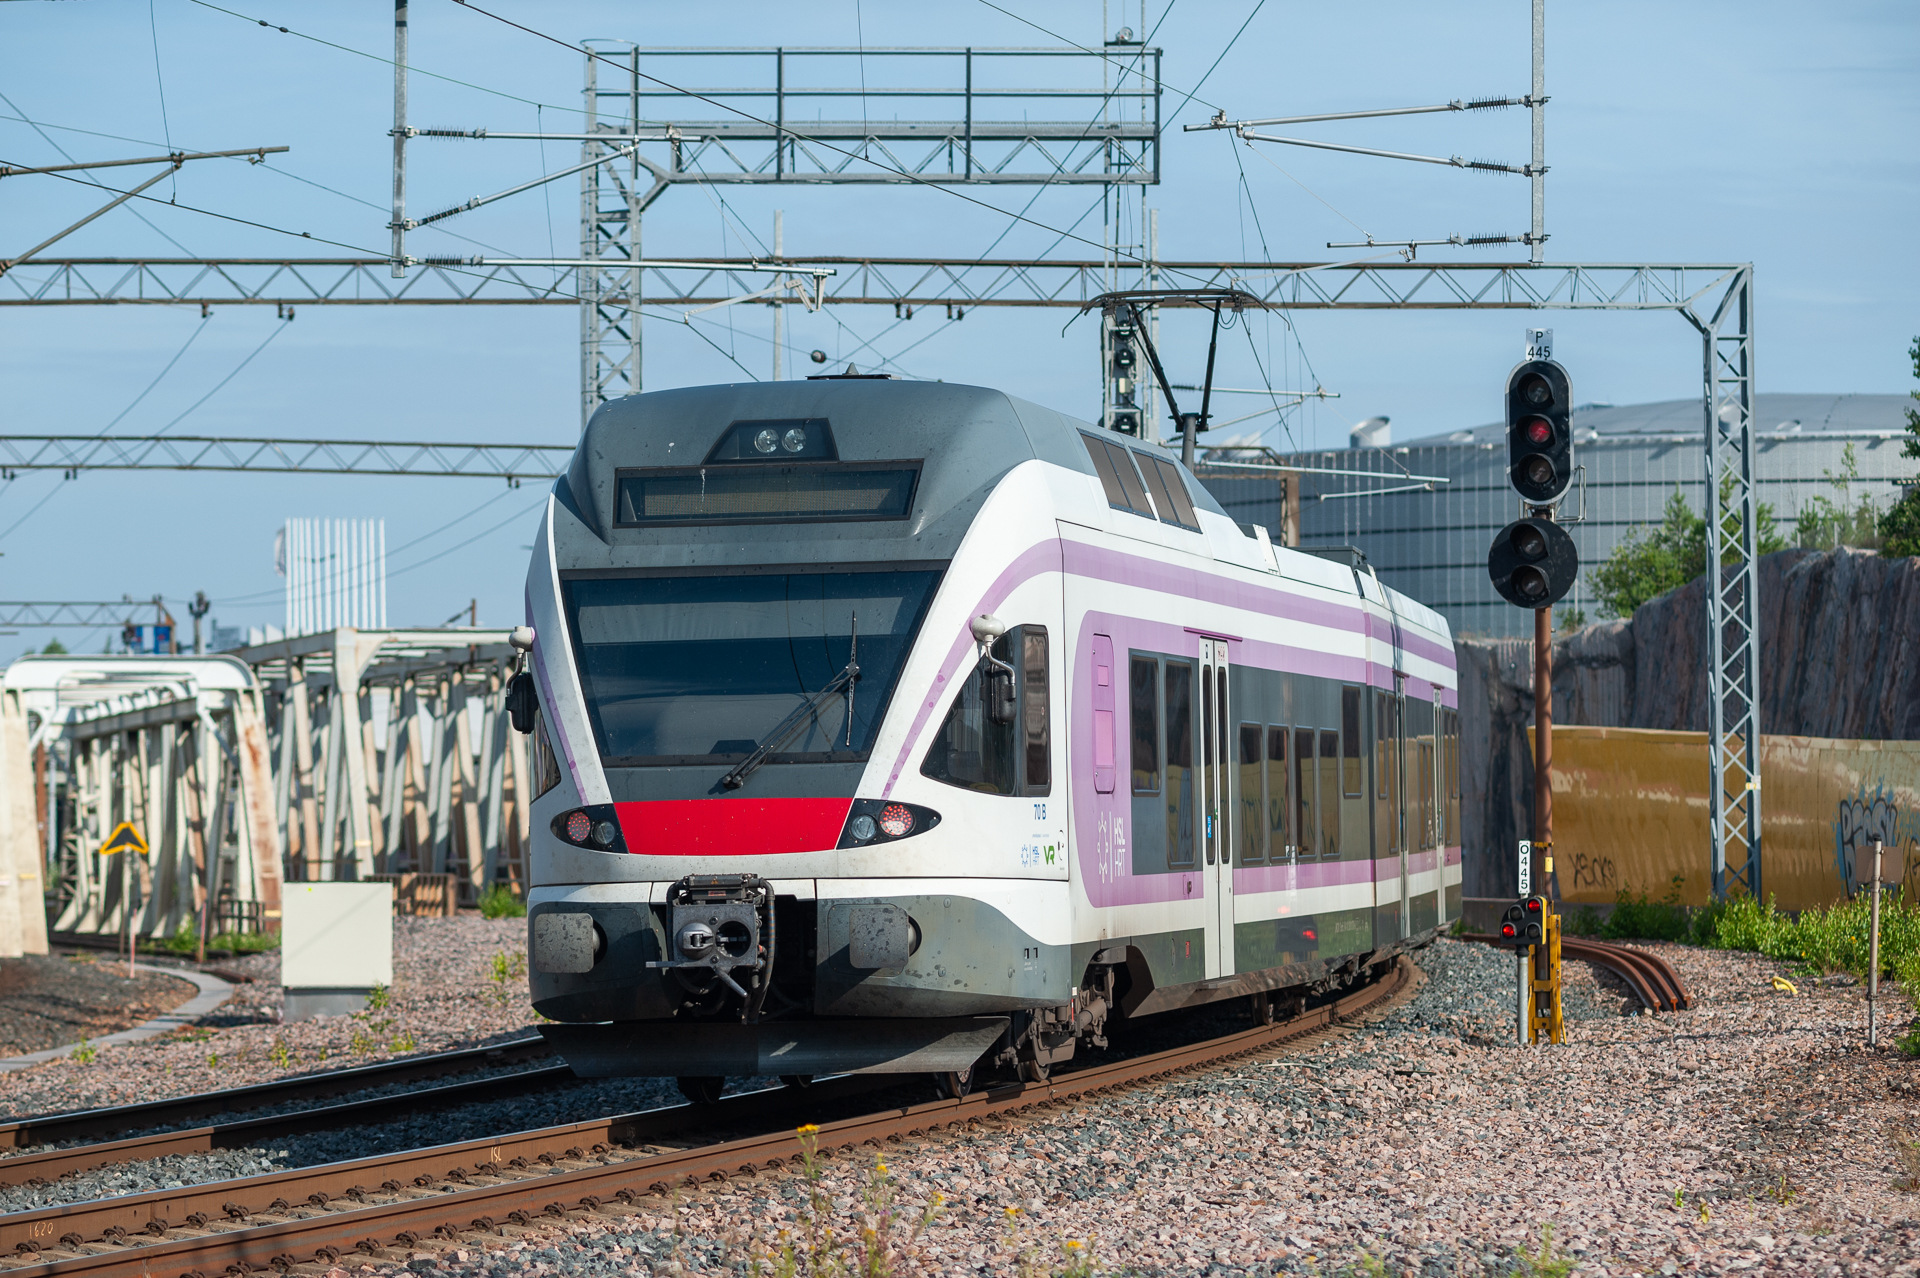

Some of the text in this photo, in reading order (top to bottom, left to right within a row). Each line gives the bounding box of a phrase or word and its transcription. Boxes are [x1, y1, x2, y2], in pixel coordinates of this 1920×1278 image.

[1535, 331, 1543, 343] P
[1527, 345, 1550, 358] 445
[1033, 803, 1047, 820] 70 B
[1113, 817, 1125, 845] HSL
[1043, 845, 1055, 865] VR
[1114, 848, 1126, 877] HRT
[29, 1221, 54, 1240] 1620
